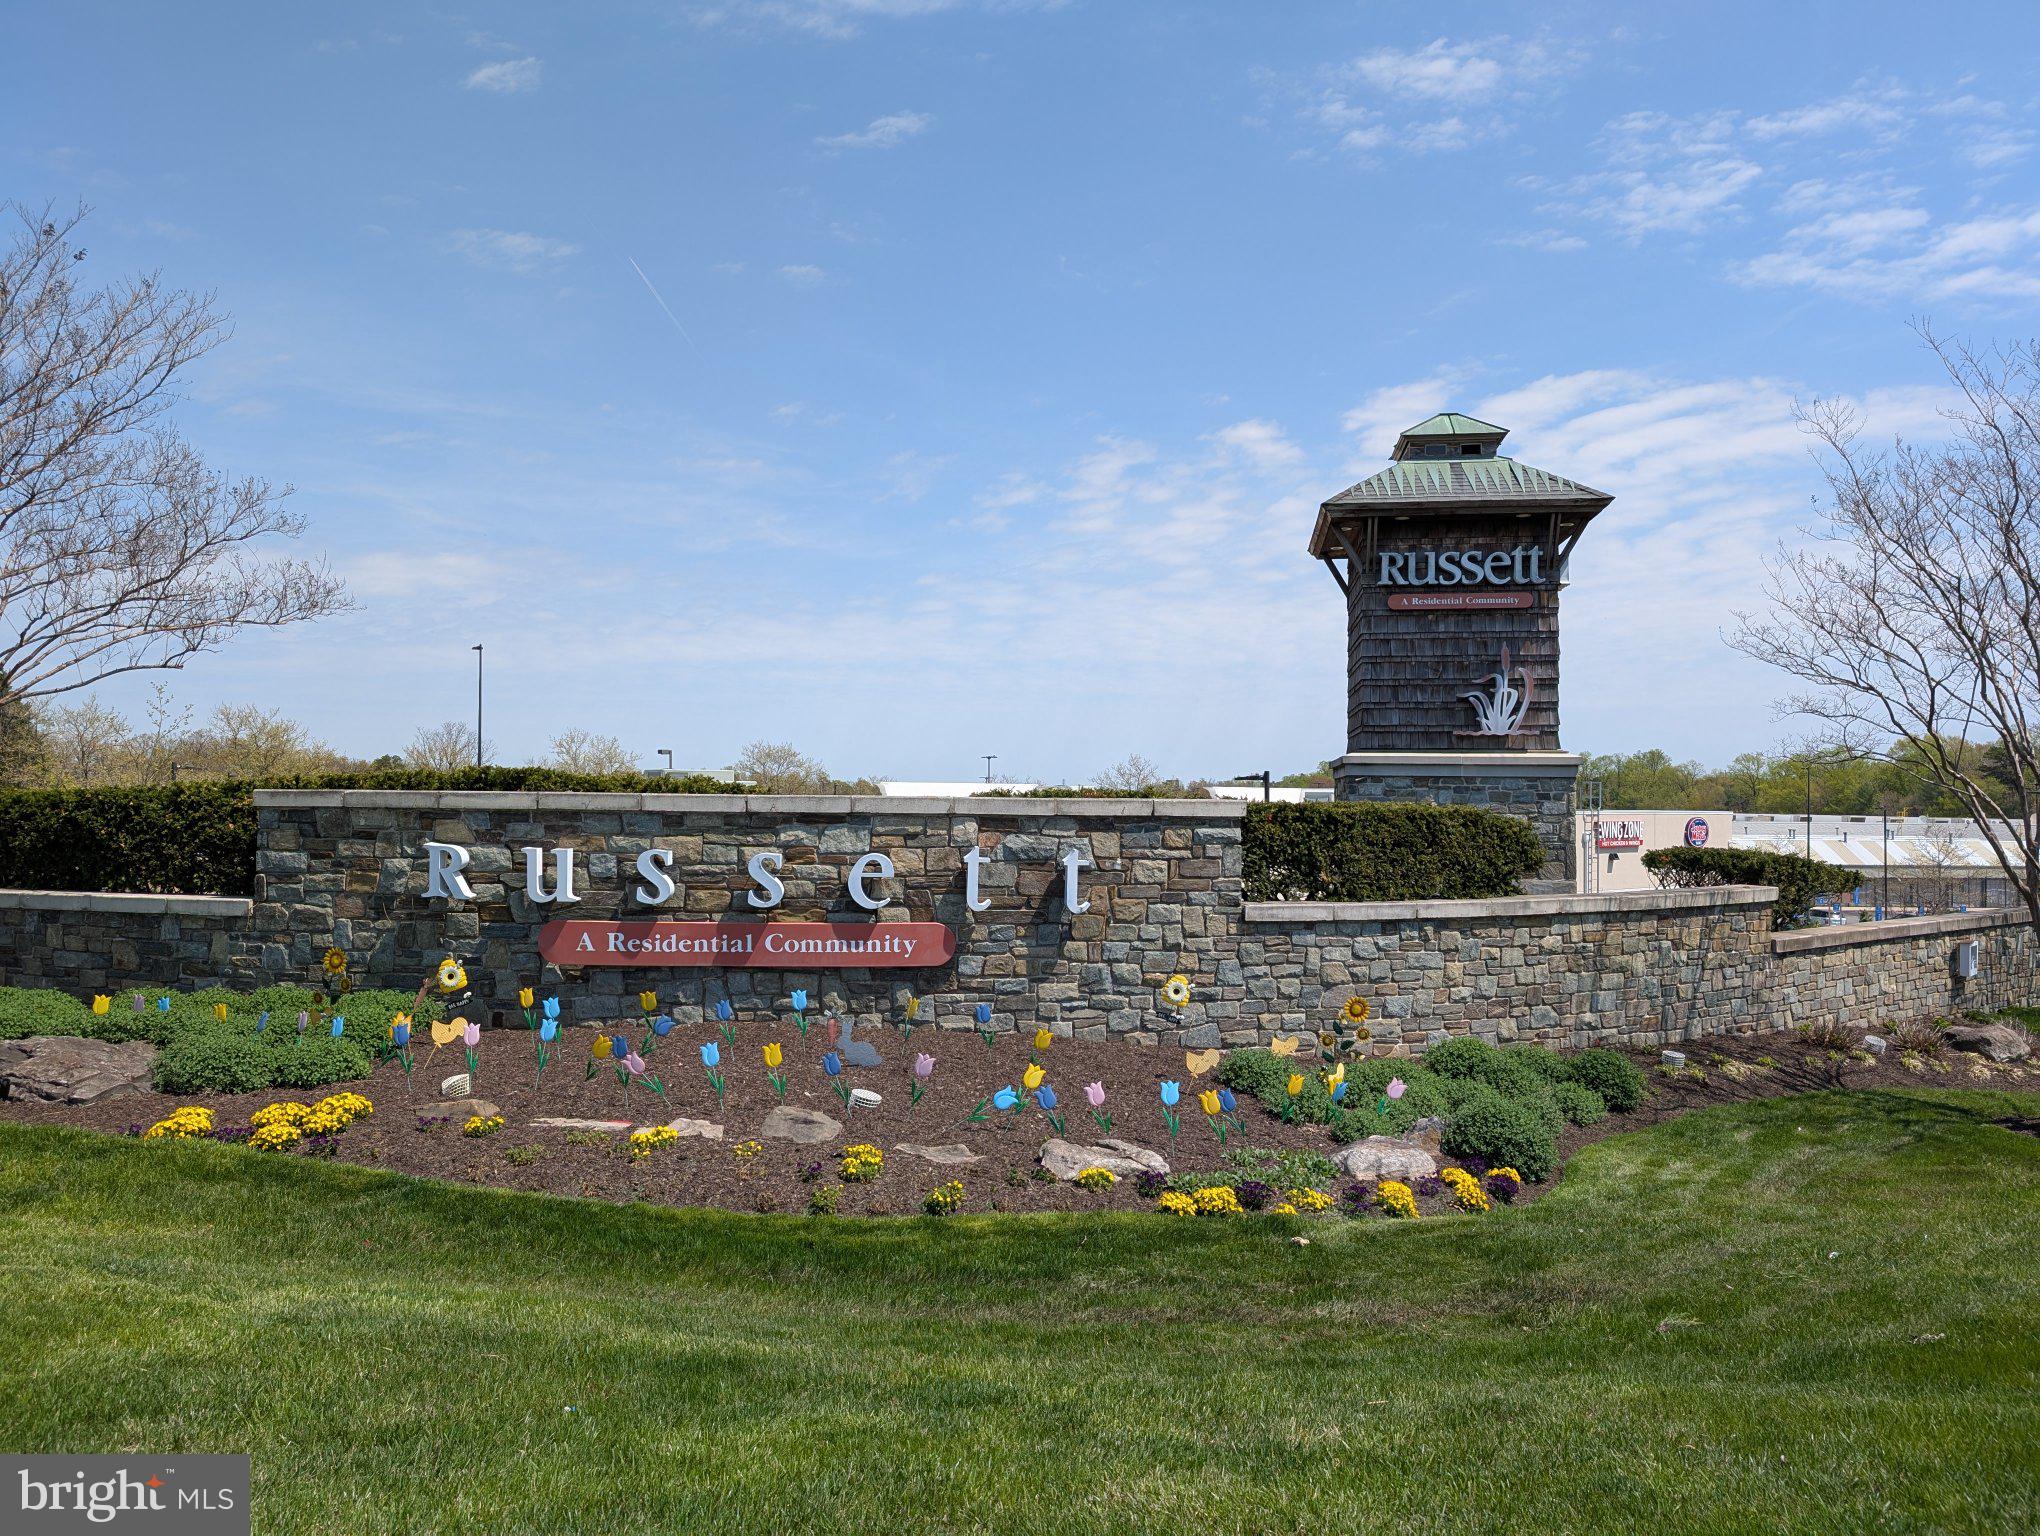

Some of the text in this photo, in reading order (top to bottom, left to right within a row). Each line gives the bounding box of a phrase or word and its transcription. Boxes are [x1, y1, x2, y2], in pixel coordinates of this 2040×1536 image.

[1377, 545, 1546, 586] Russett
[1412, 597, 1463, 605] Residential
[1466, 596, 1520, 605] Community
[421, 842, 1090, 914] Russett
[576, 932, 918, 958] A Residential Community
